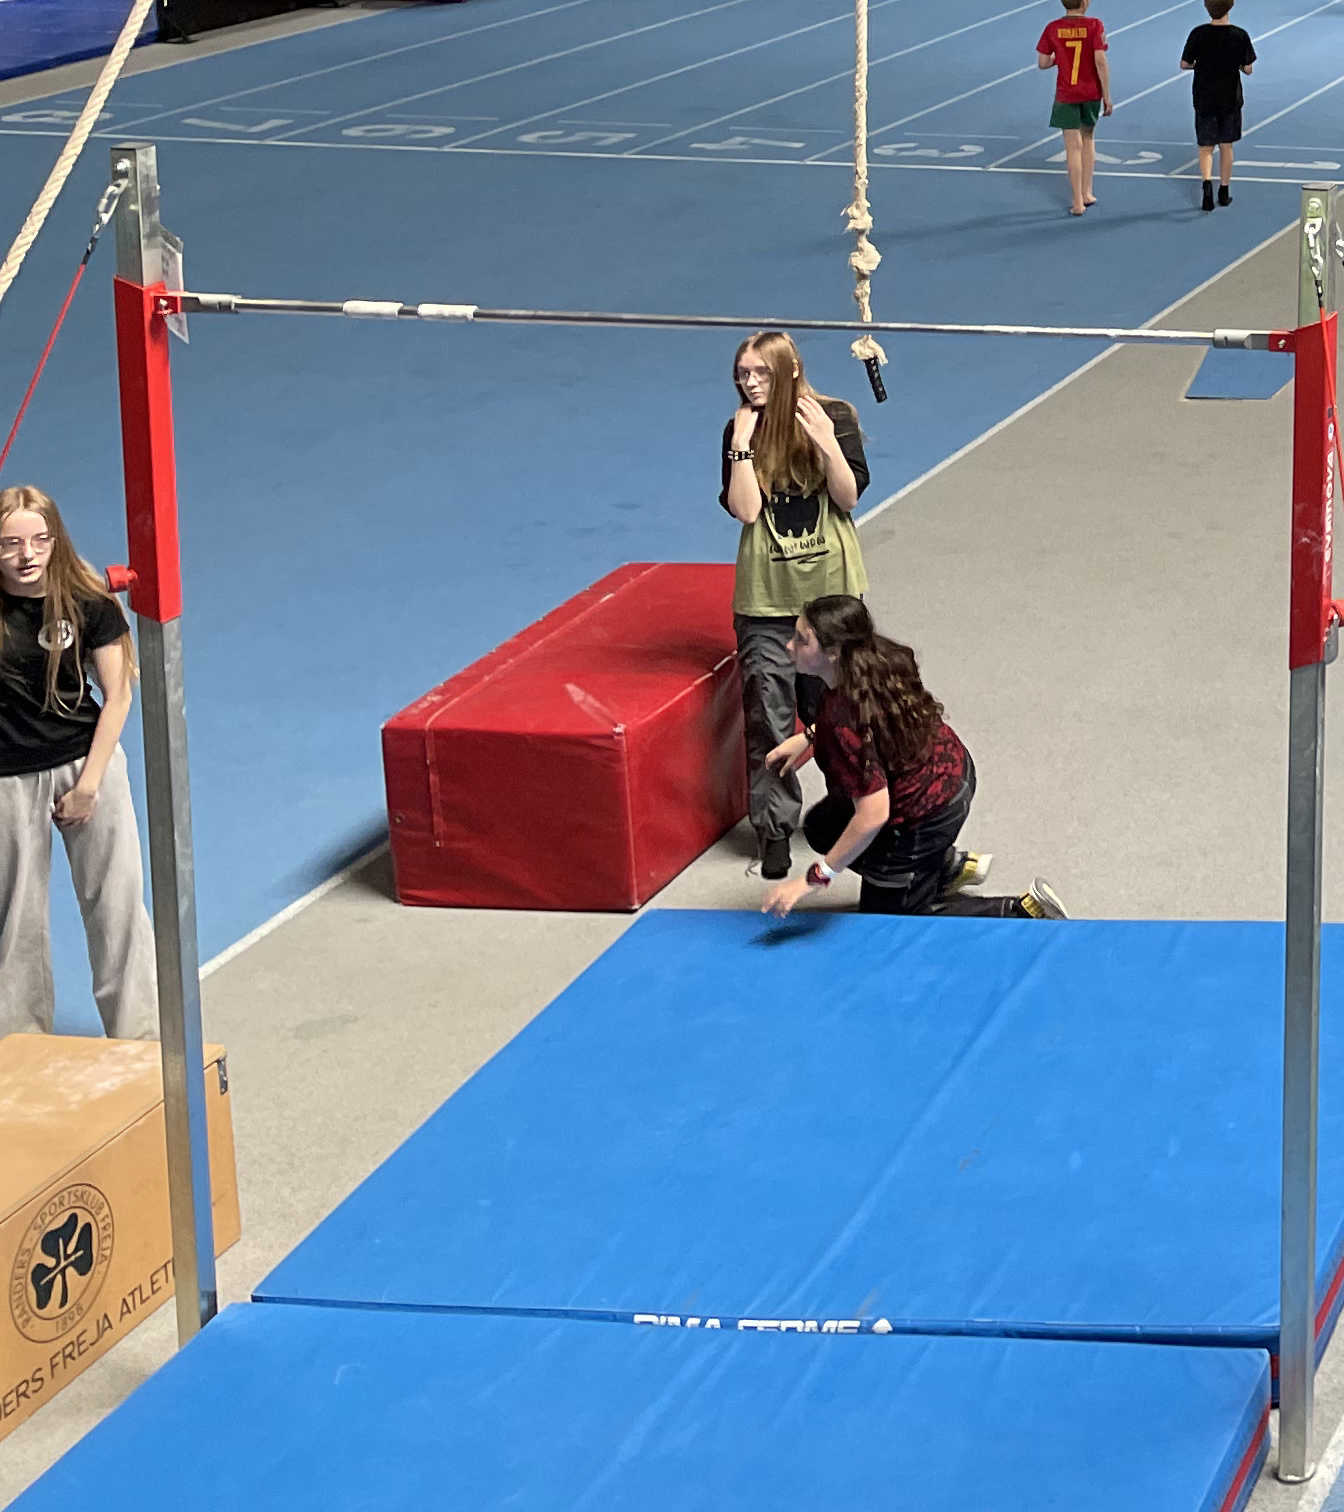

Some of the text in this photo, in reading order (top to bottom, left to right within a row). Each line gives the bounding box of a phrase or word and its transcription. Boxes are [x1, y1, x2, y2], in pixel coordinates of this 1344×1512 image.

[1065, 40, 1082, 85] 7
[181, 118, 295, 133] 7
[516, 129, 638, 147] 5
[688, 136, 807, 151] 4
[873, 141, 986, 159] 3
[33, 1189, 106, 1232] SPORTSKLUB
[49, 1312, 114, 1378] FREJA
